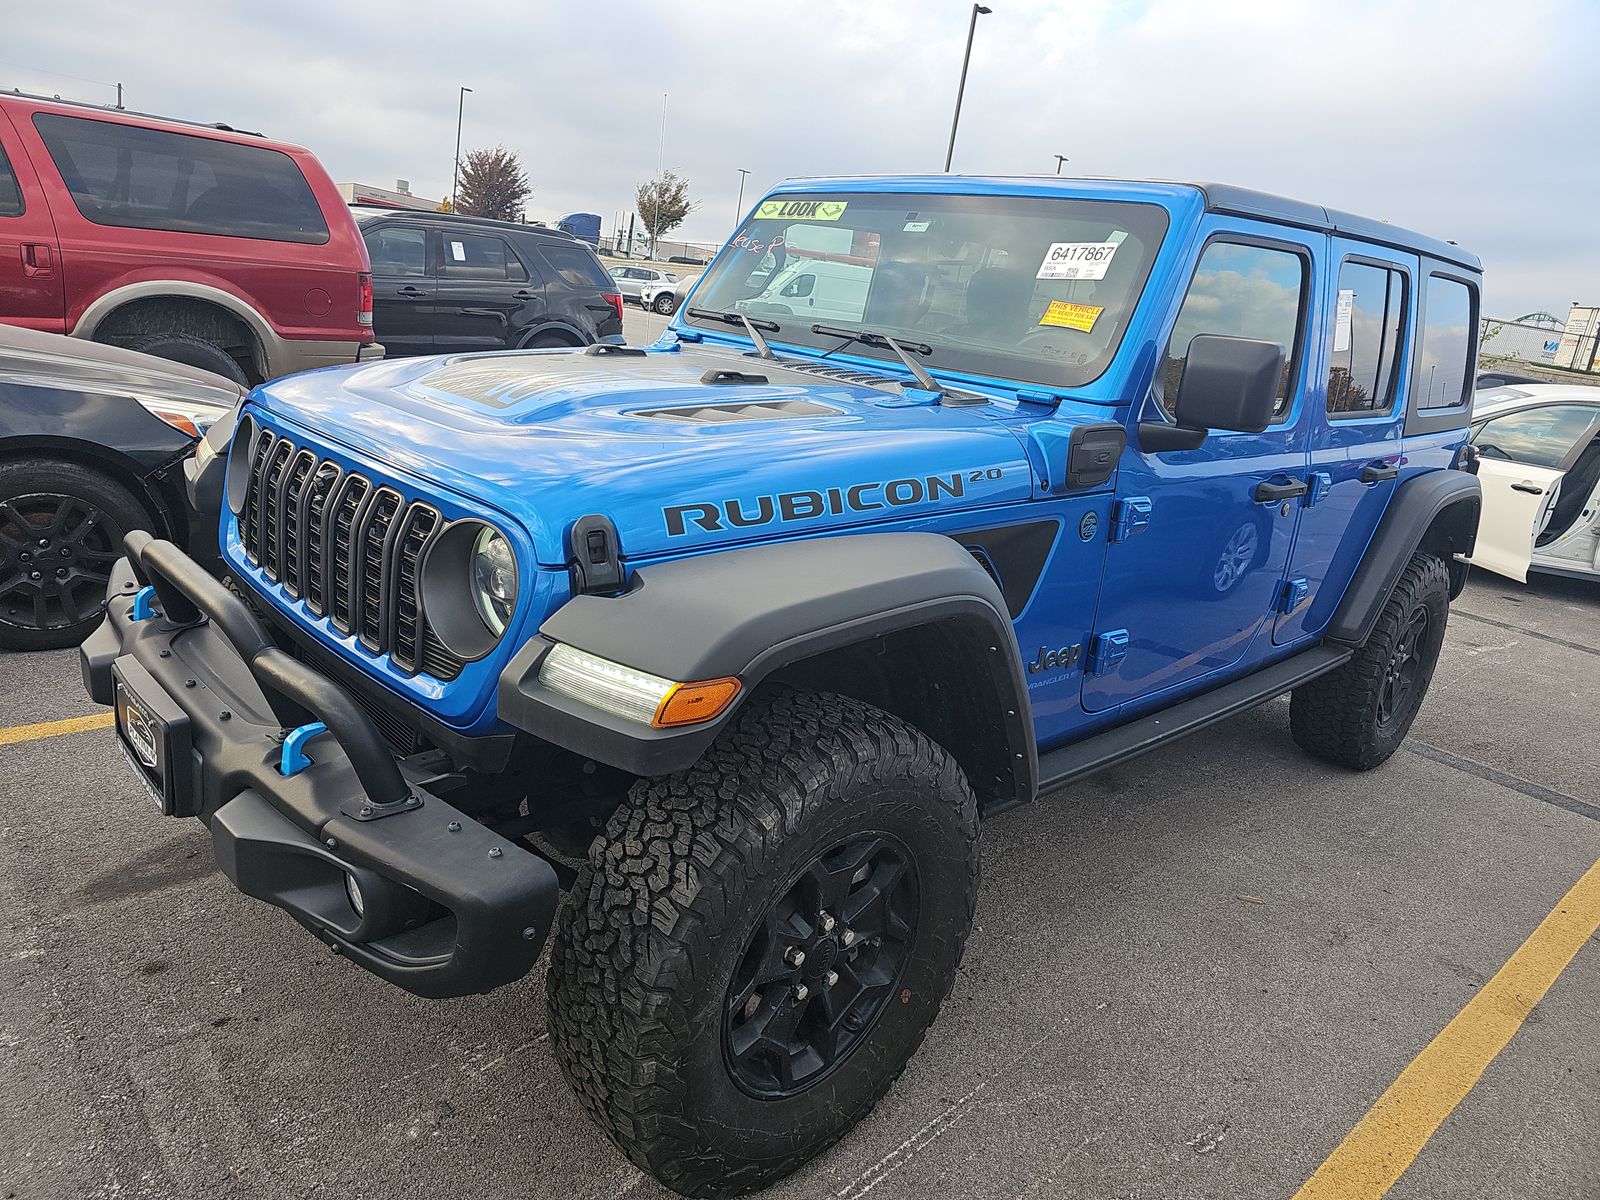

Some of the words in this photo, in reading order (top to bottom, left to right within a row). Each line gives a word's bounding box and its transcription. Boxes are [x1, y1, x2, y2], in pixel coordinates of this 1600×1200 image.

[777, 201, 822, 218] LOOK
[1051, 246, 1115, 261] 6417867
[1051, 301, 1068, 310] THIS
[1069, 304, 1102, 315] VEHICLE
[664, 473, 967, 537] RUBICON
[968, 467, 1003, 484] 20
[1028, 643, 1081, 673] Jeep
